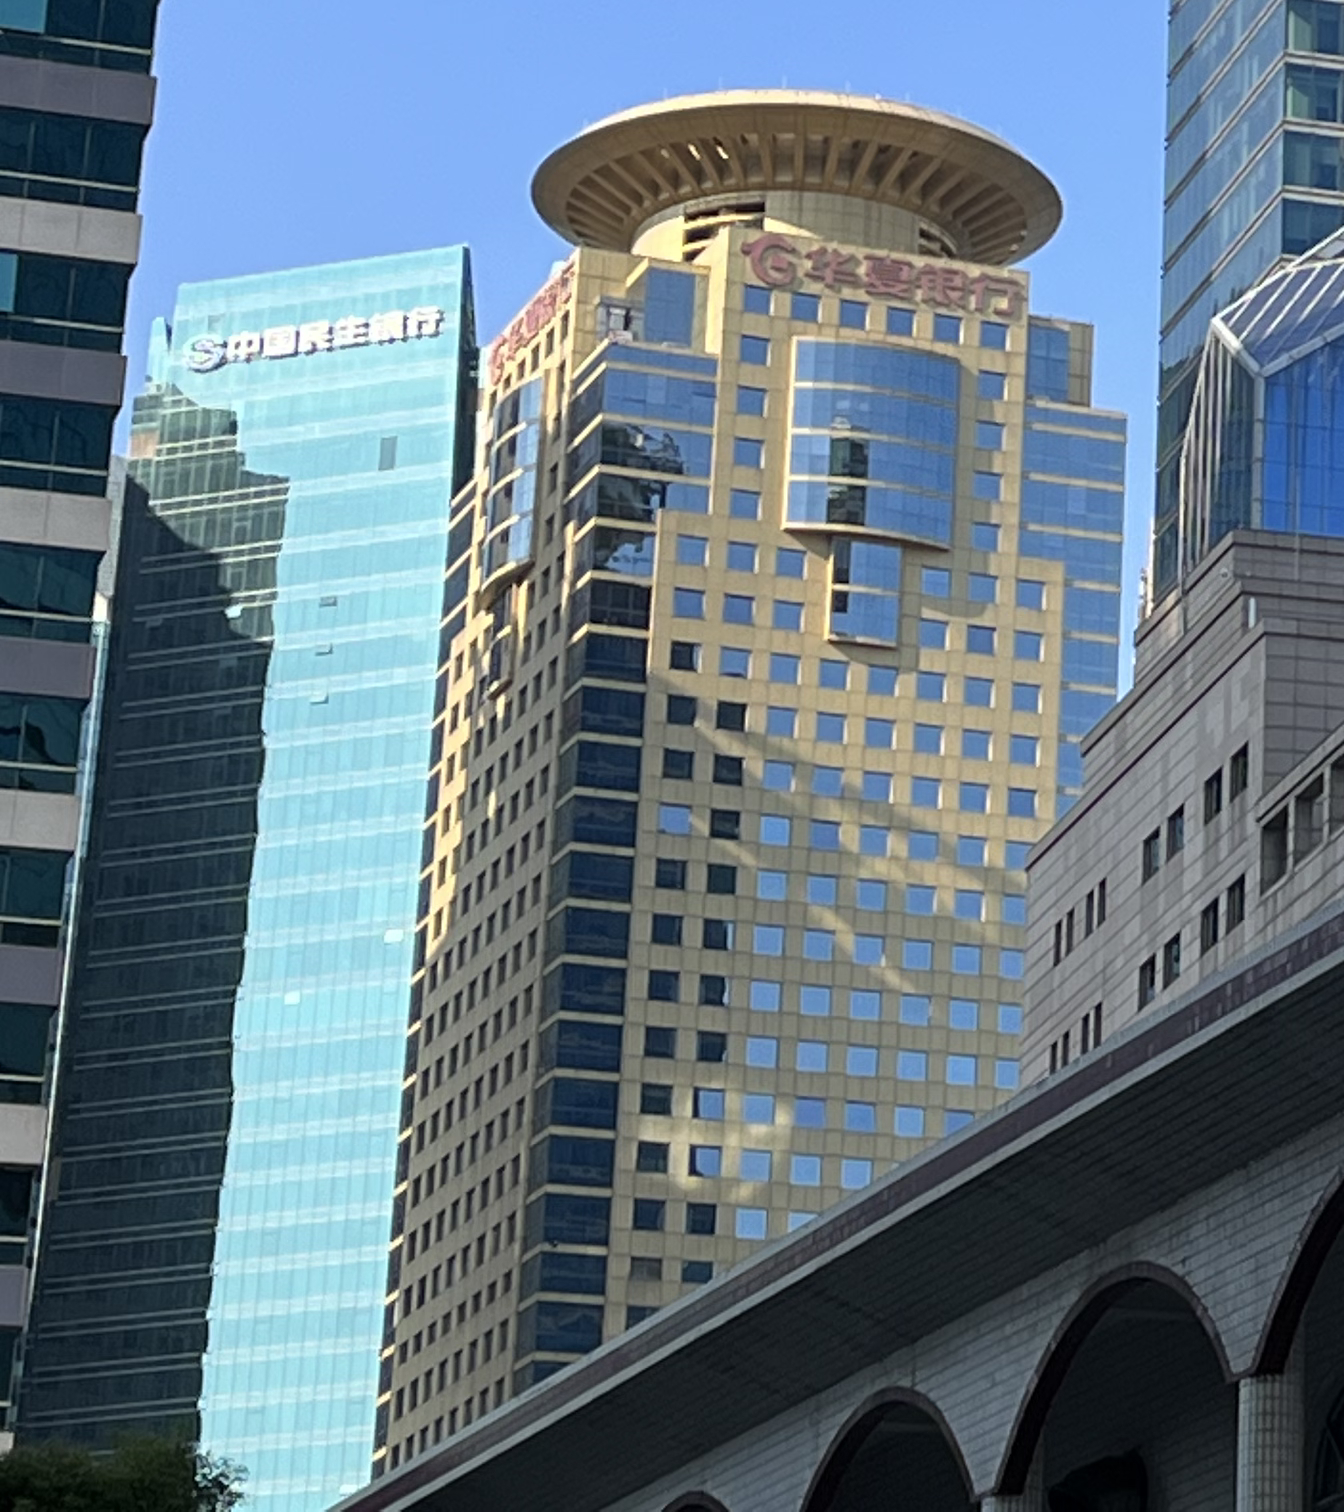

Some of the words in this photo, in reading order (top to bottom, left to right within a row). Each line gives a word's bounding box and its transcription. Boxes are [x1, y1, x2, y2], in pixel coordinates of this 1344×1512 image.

[804, 245, 1028, 317] 华夏银行
[226, 306, 444, 362] 中国民生银行
